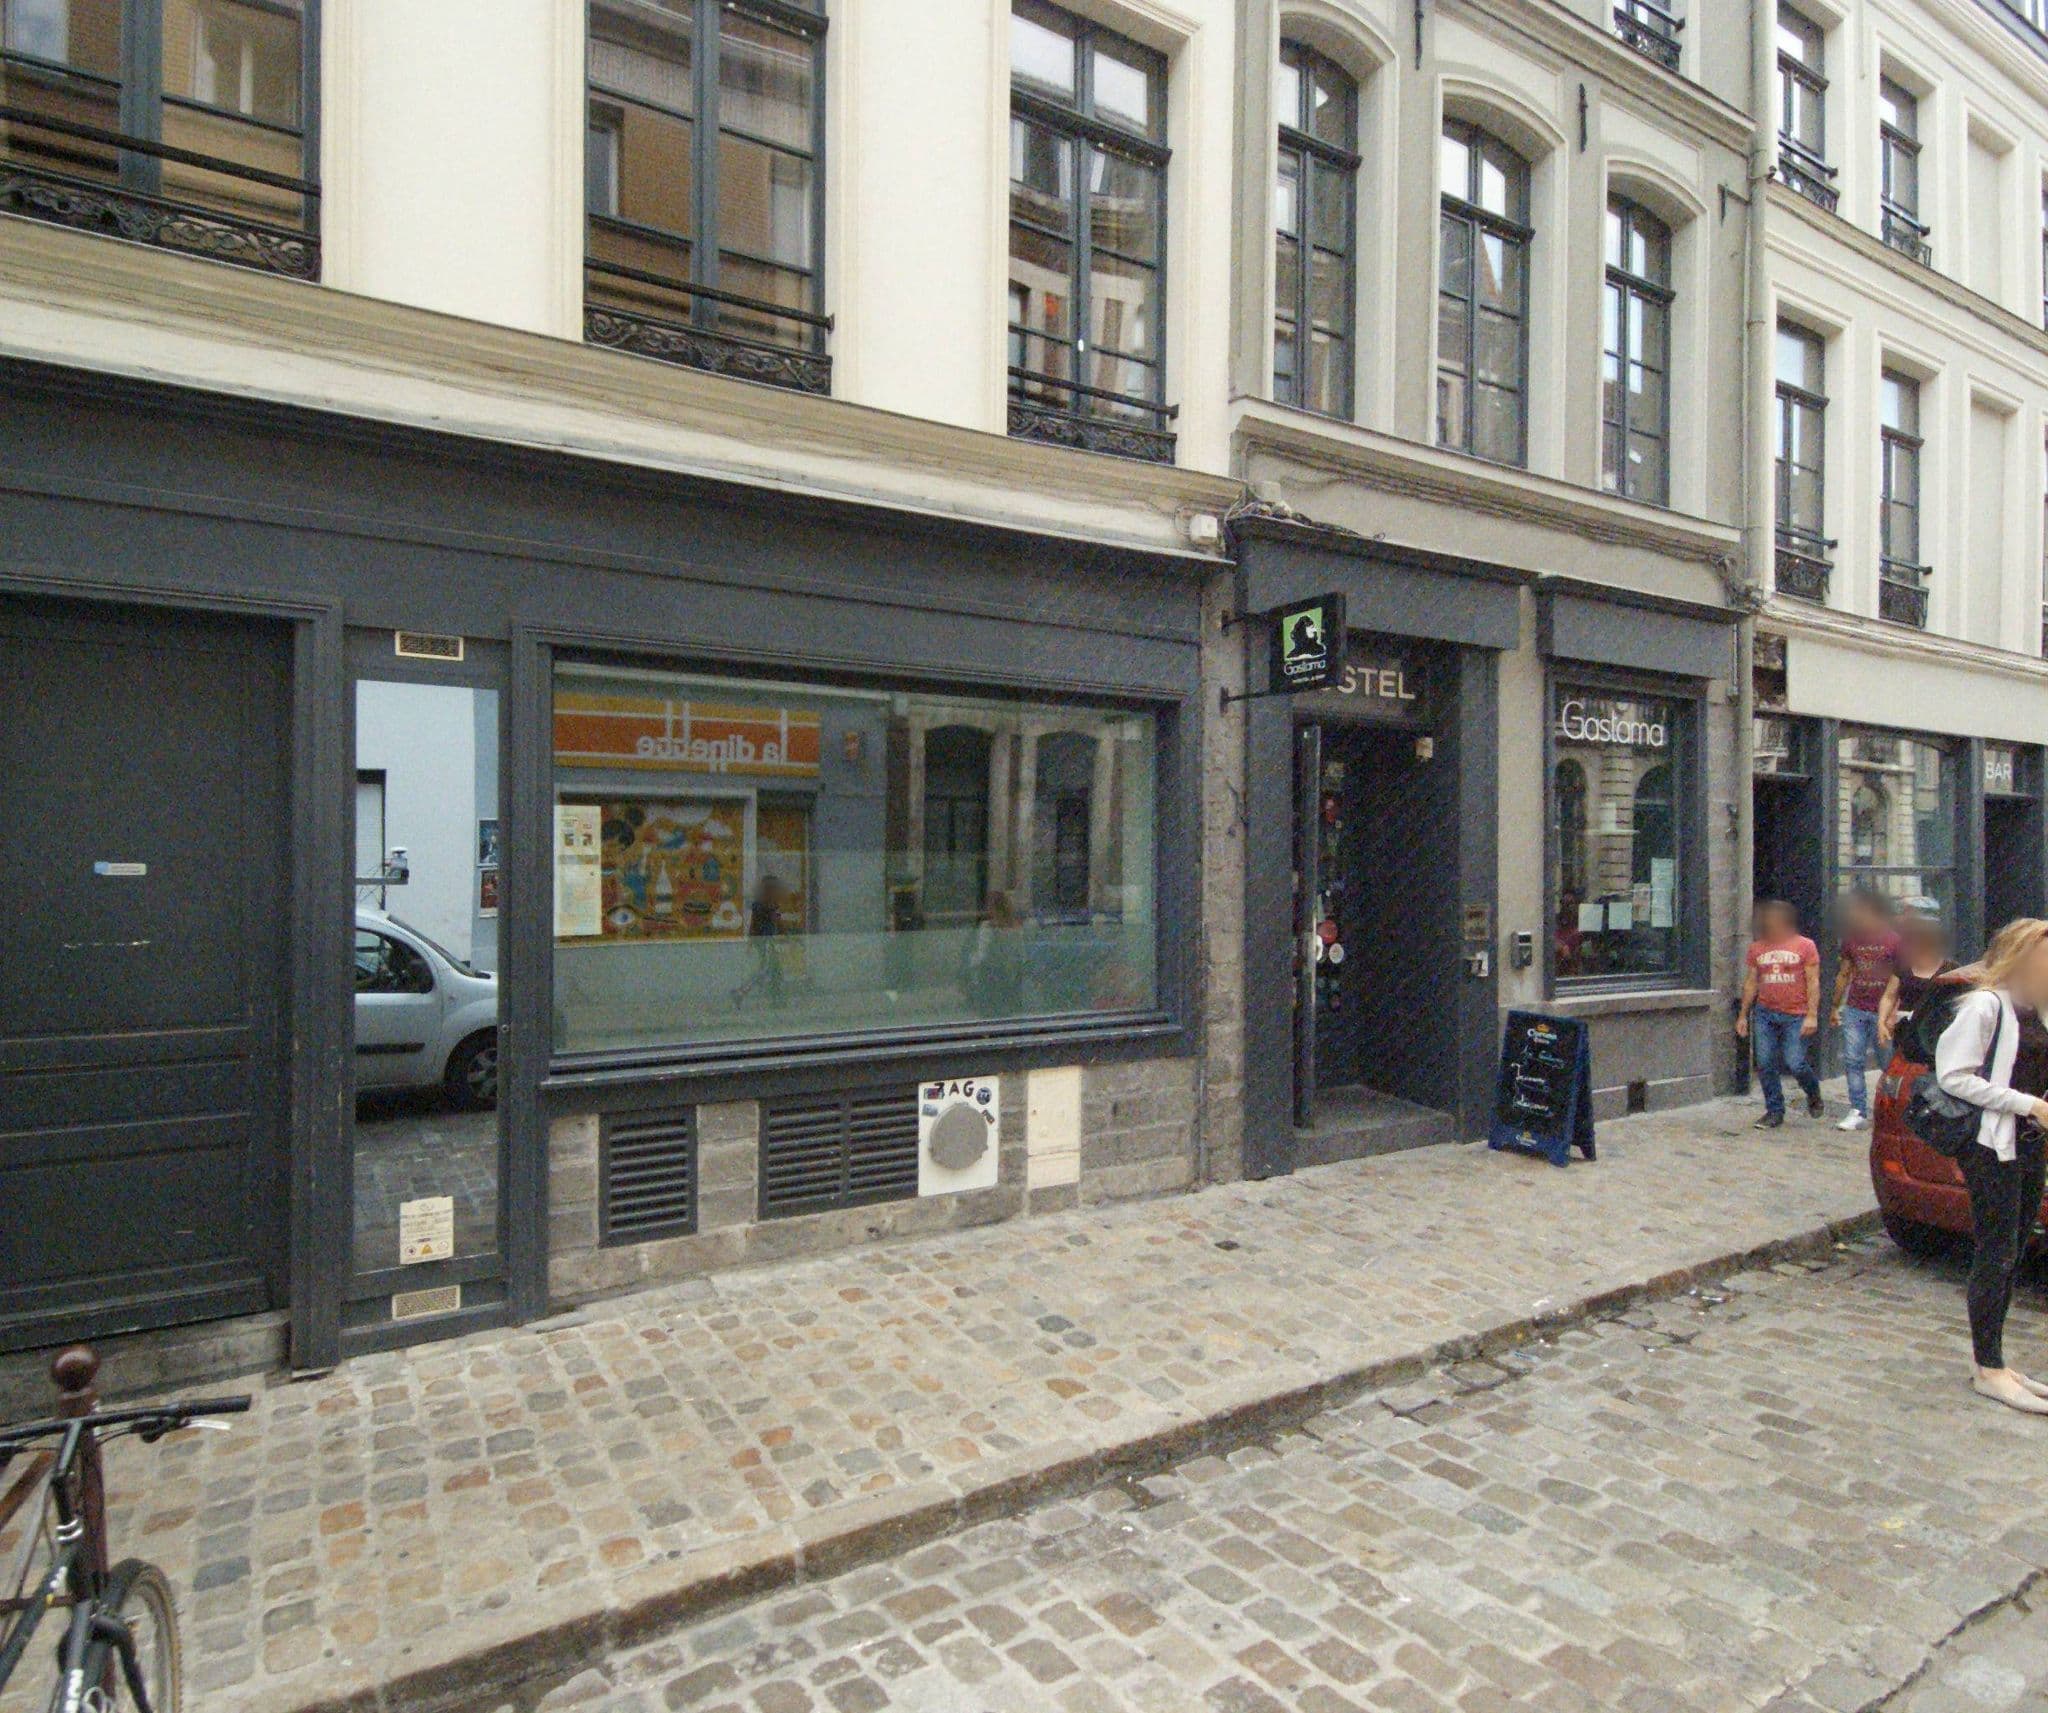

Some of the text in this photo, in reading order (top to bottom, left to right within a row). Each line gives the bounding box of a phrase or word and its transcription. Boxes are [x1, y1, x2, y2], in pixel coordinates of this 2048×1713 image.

[1283, 660, 1327, 676] Gastama
[1336, 664, 1416, 700] STEL
[1562, 700, 1665, 747] Gastama
[1984, 761, 2013, 784] BAR
